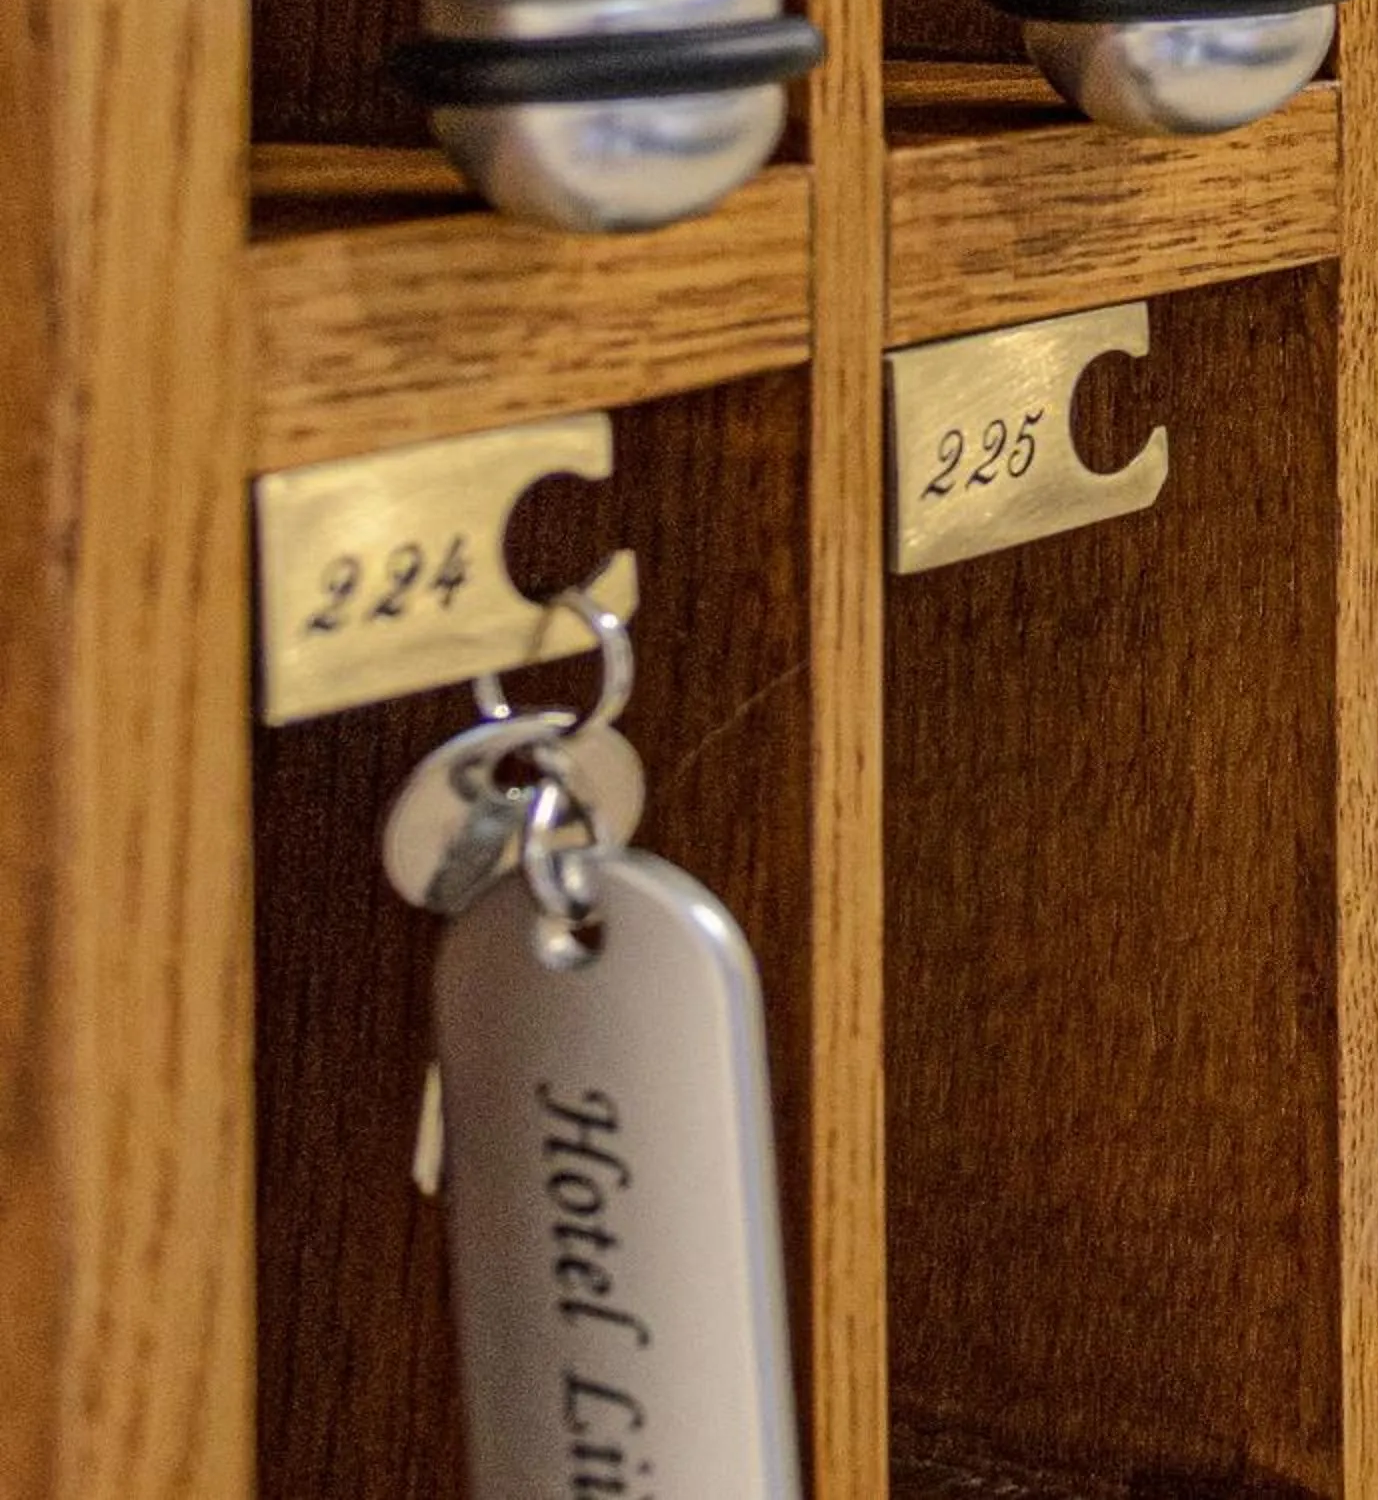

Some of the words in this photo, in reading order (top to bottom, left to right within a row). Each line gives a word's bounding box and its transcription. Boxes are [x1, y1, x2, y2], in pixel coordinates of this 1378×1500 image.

[920, 408, 1045, 499] 225
[303, 533, 469, 635] 224
[534, 1080, 653, 1350] Hotel
